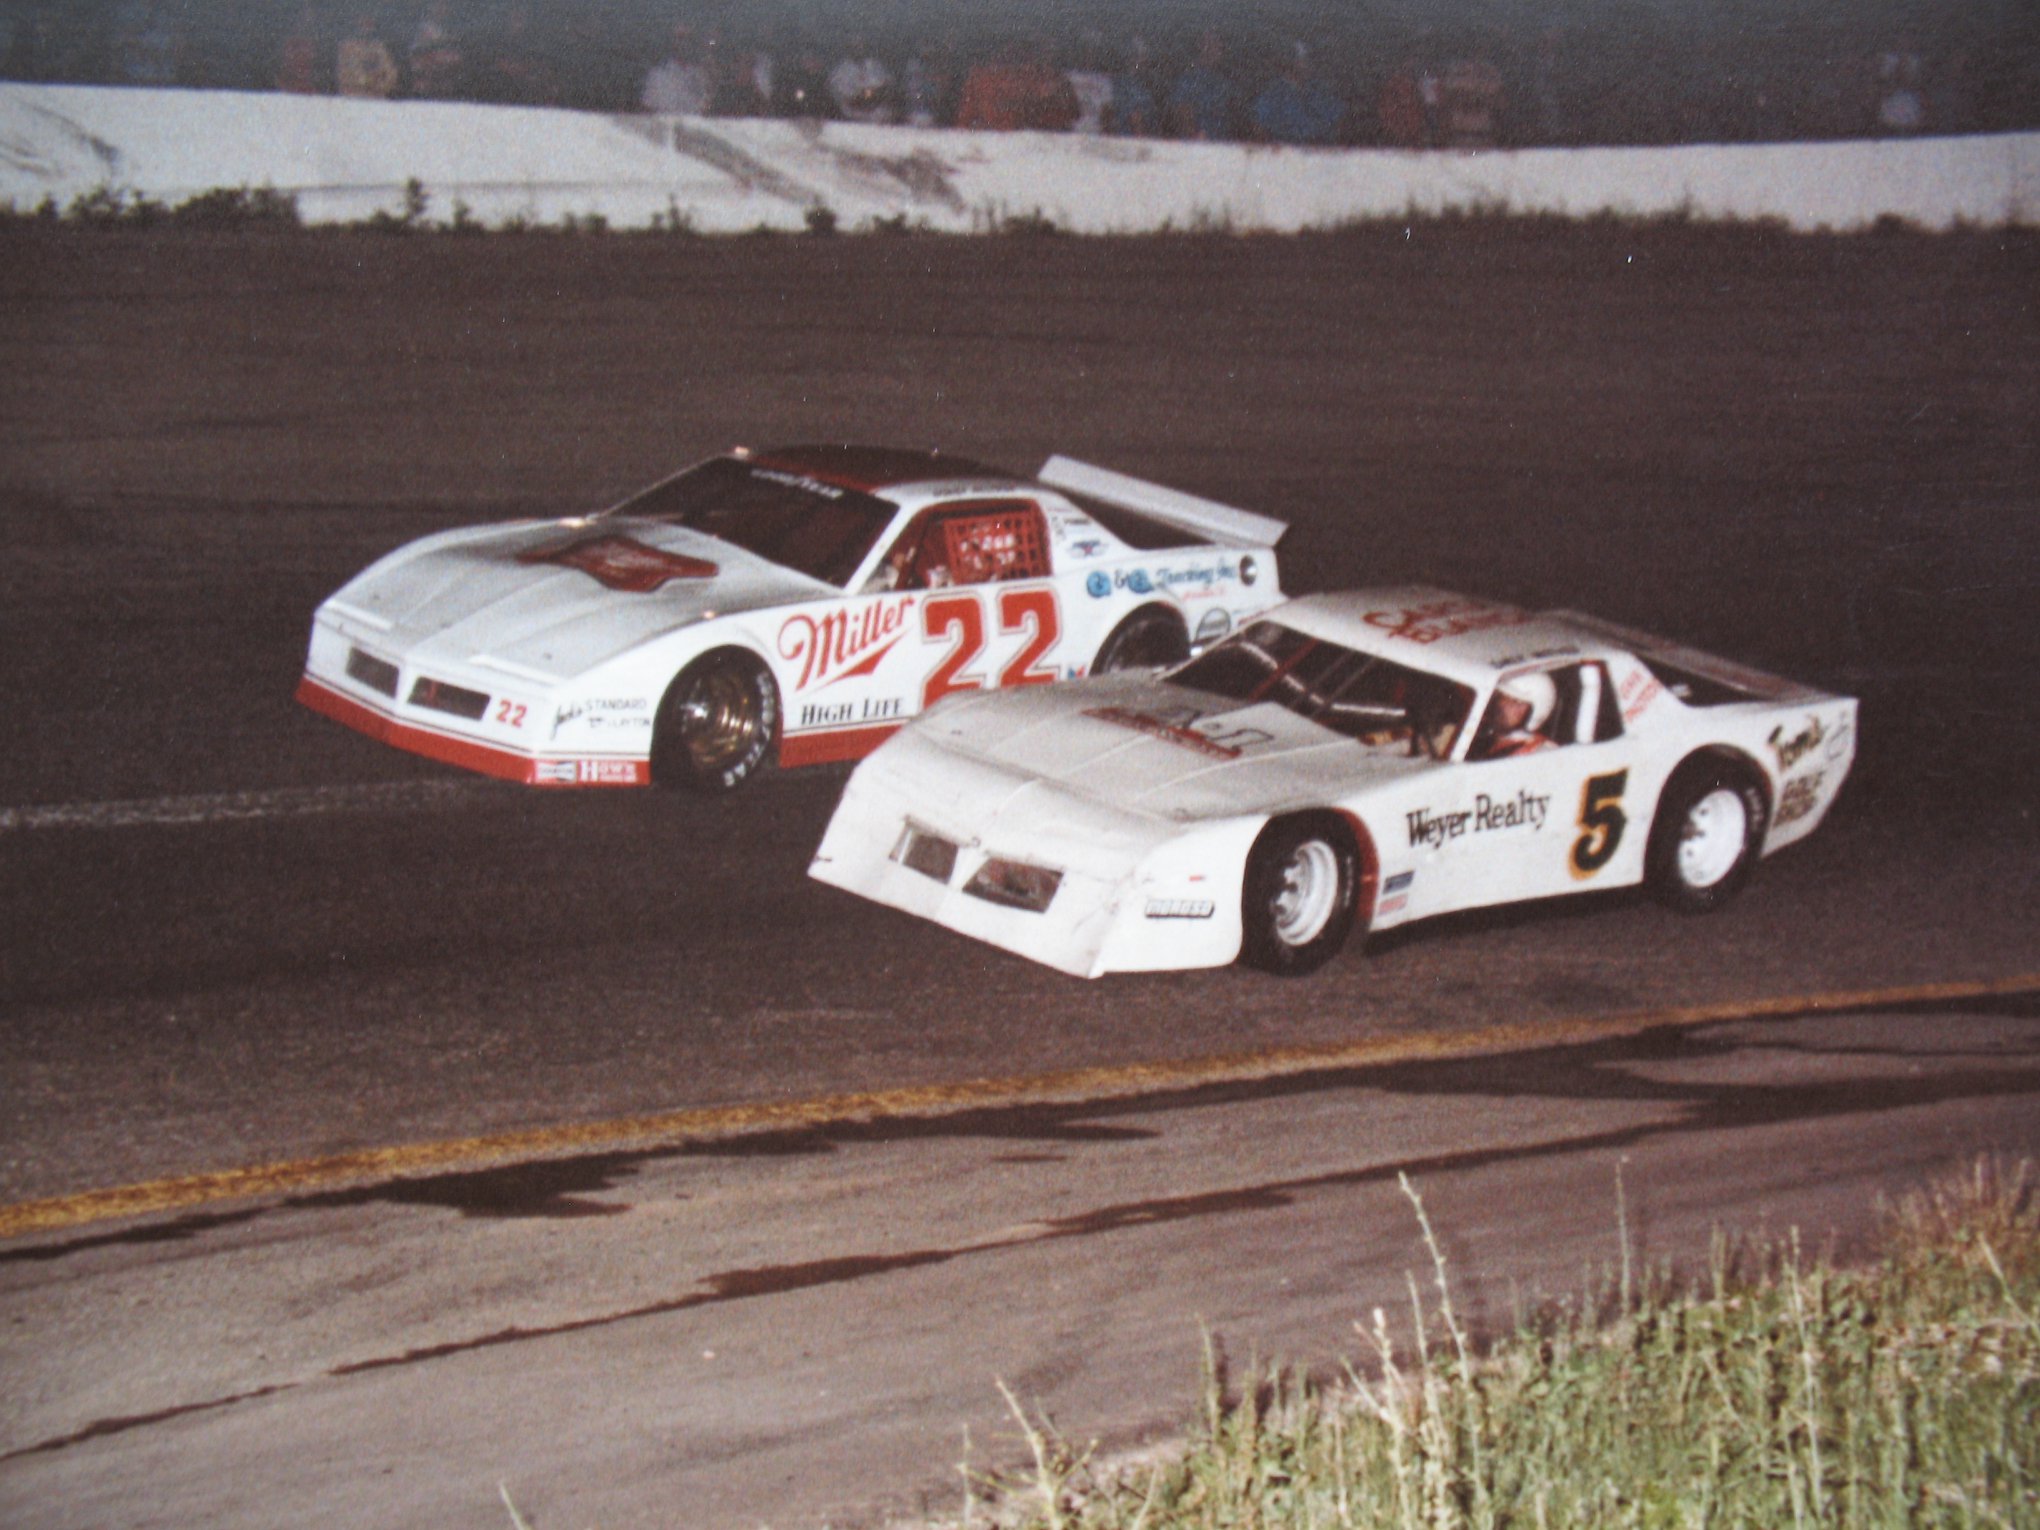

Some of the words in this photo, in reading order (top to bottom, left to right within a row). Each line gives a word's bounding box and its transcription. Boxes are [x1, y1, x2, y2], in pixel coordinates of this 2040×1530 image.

[777, 594, 915, 692] Miller
[922, 583, 1063, 713] 22
[496, 699, 527, 728] 22
[800, 703, 852, 726] HIGH
[862, 697, 903, 719] LIFE
[1405, 807, 1473, 849] Weyer
[1474, 788, 1551, 832] Realty
[1567, 767, 1630, 881] 5
